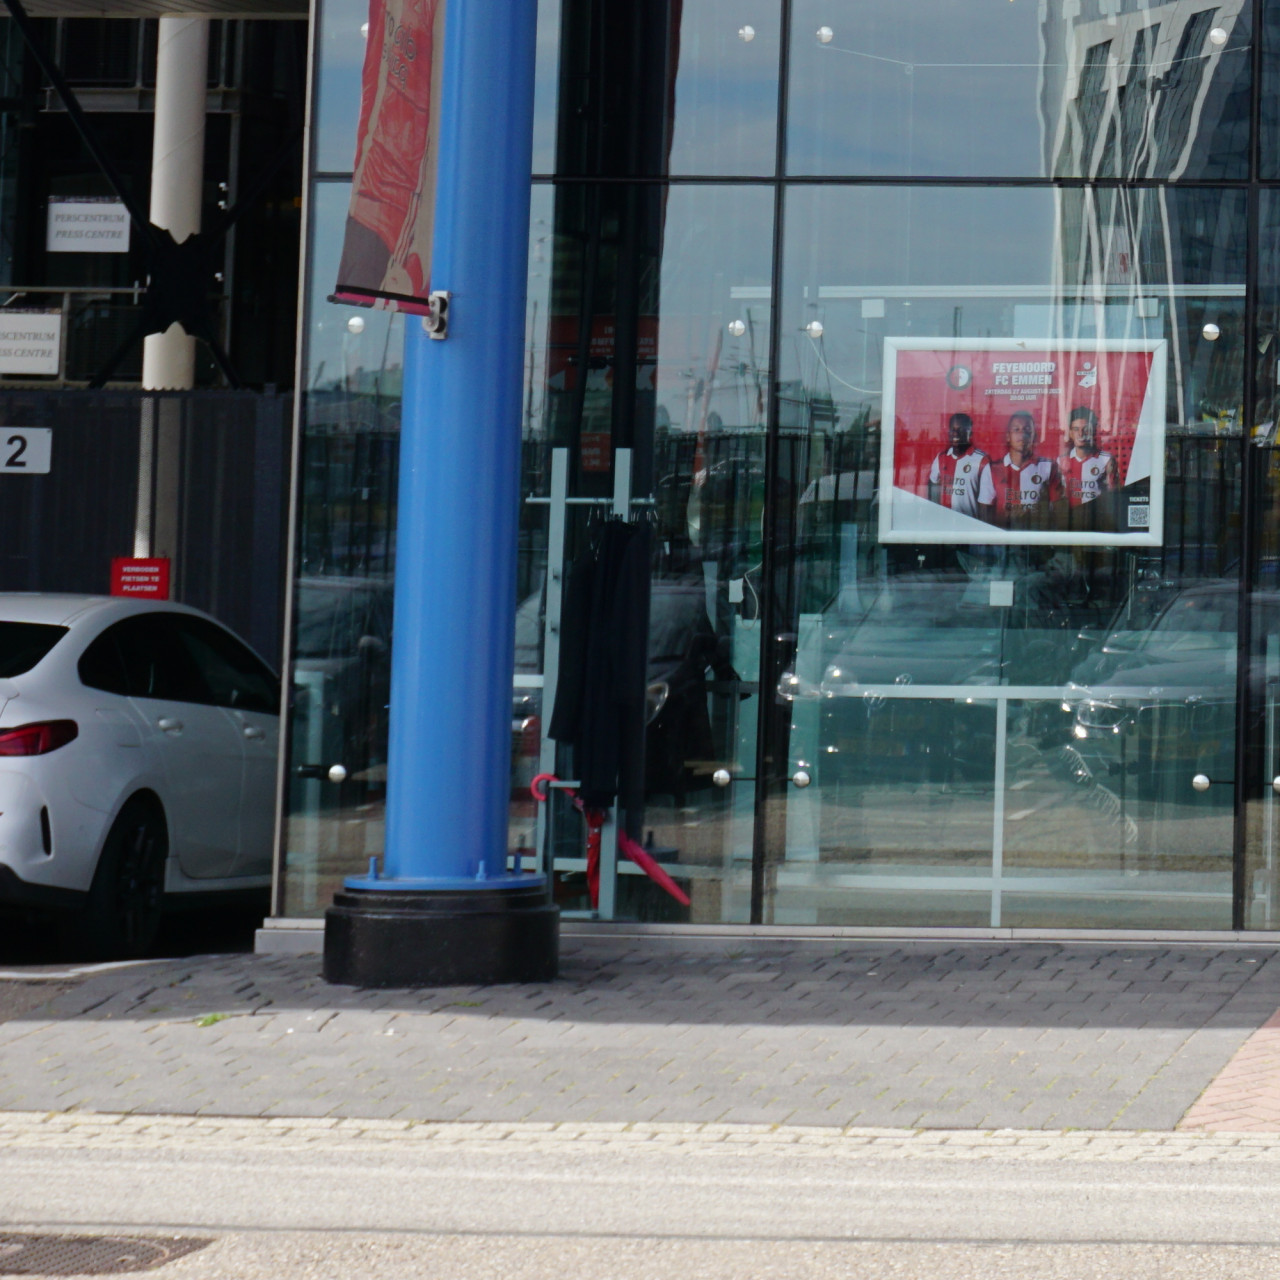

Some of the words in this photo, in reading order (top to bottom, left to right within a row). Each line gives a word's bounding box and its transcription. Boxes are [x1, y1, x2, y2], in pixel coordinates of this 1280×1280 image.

[55, 214, 125, 223] PERSCENTRUM
[56, 230, 84, 239] PRESS
[85, 230, 123, 239] CENTRE
[14, 349, 53, 358] CENTRE
[993, 362, 1055, 373] FEYENOORD
[995, 375, 1009, 385] FC
[1012, 374, 1052, 385] EMMEN
[5, 435, 28, 467] 2
